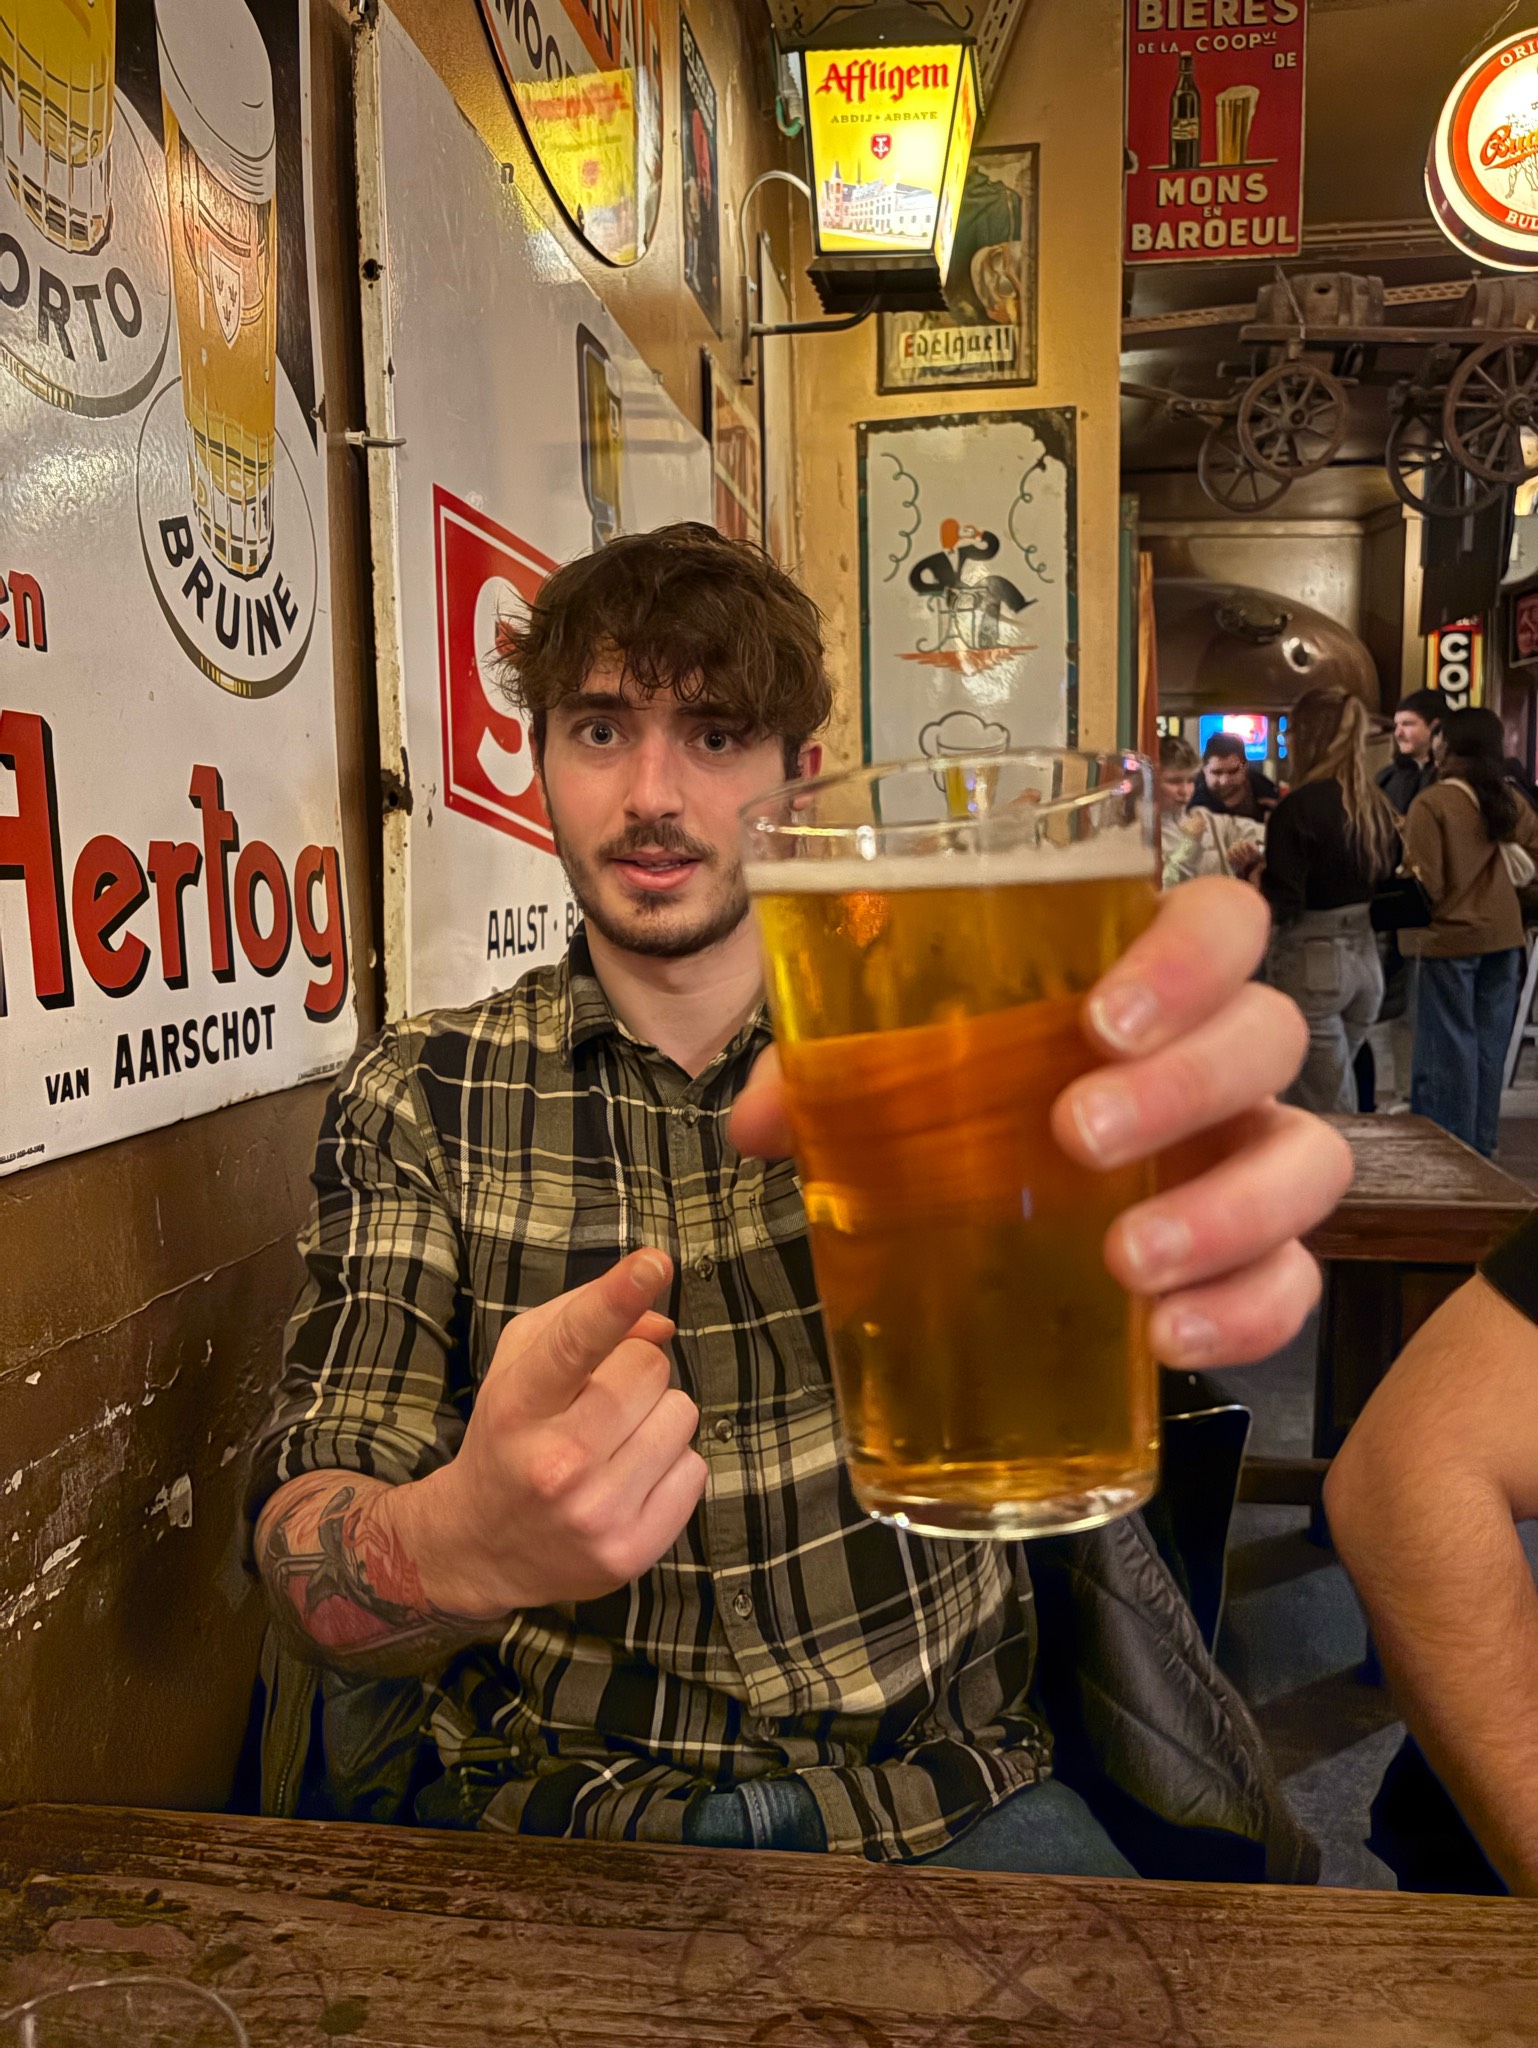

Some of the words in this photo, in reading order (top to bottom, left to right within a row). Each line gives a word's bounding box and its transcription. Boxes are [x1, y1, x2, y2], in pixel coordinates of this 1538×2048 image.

[1138, 43, 1155, 54] DE
[1160, 42, 1178, 53] LA
[1274, 52, 1297, 68] DE
[1500, 40, 1538, 67] ORI
[815, 59, 949, 103] Affligem
[831, 114, 872, 123] ABDIJ
[884, 112, 938, 122] ABBAYE
[1158, 173, 1268, 206] MONS
[1203, 206, 1222, 218] EN
[1131, 216, 1296, 251] BAROEUL
[904, 327, 1010, 360] Edelquell
[158, 515, 299, 656] BRUINE
[487, 904, 548, 960] AALST
[45, 1067, 89, 1105] VAN
[113, 1004, 275, 1089] AARSCHOT
